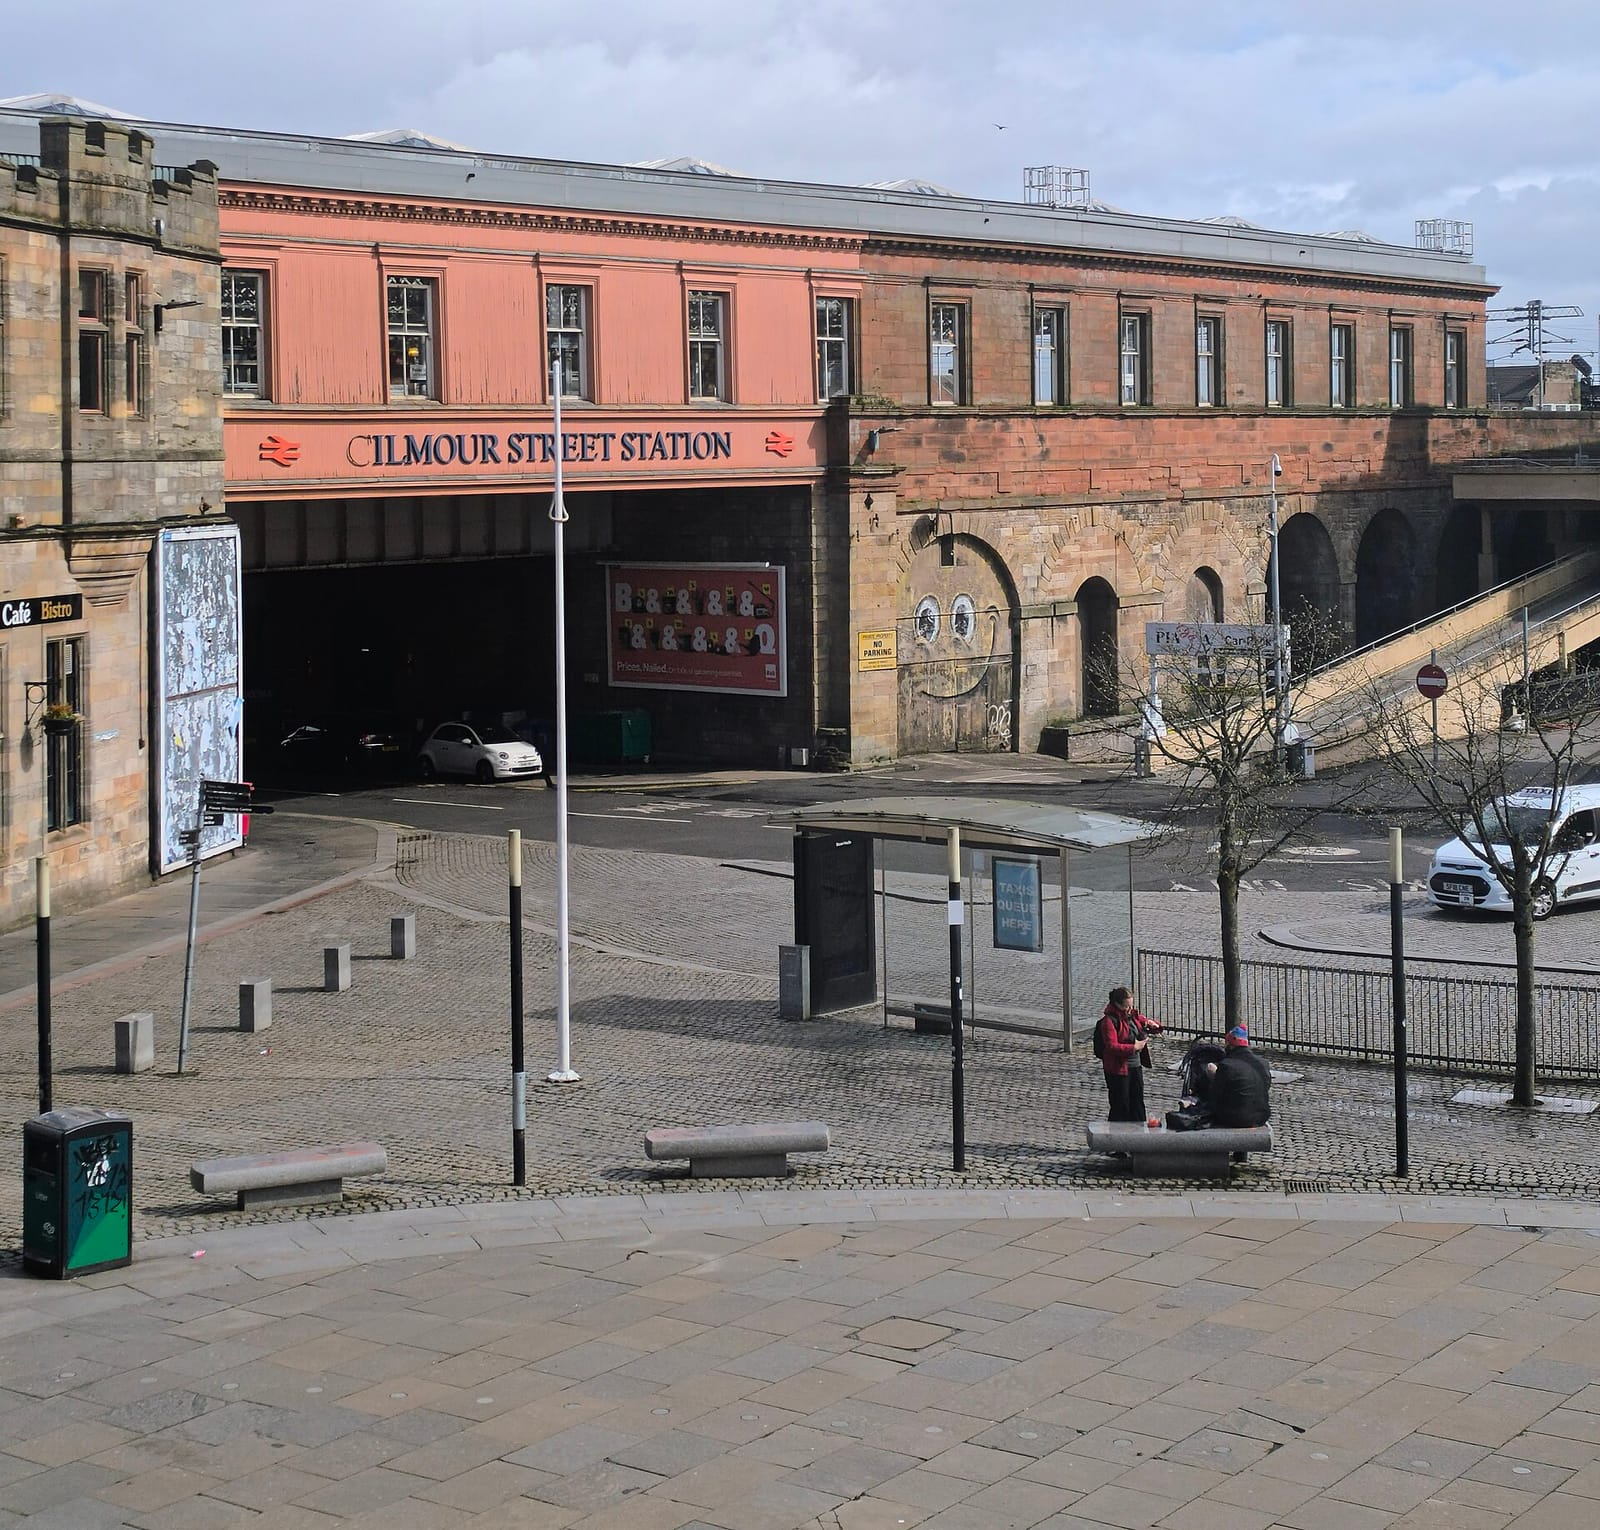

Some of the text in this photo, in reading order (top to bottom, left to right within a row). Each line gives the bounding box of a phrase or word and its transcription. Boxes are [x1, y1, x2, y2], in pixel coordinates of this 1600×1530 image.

[507, 432, 616, 464] STREET
[620, 431, 733, 462] STATION
[2, 600, 73, 626] Café Bistro
[873, 640, 883, 648] NO
[863, 648, 892, 657] PARKING
[997, 900, 1036, 914] QUEUE
[1001, 917, 1033, 931] HERE
